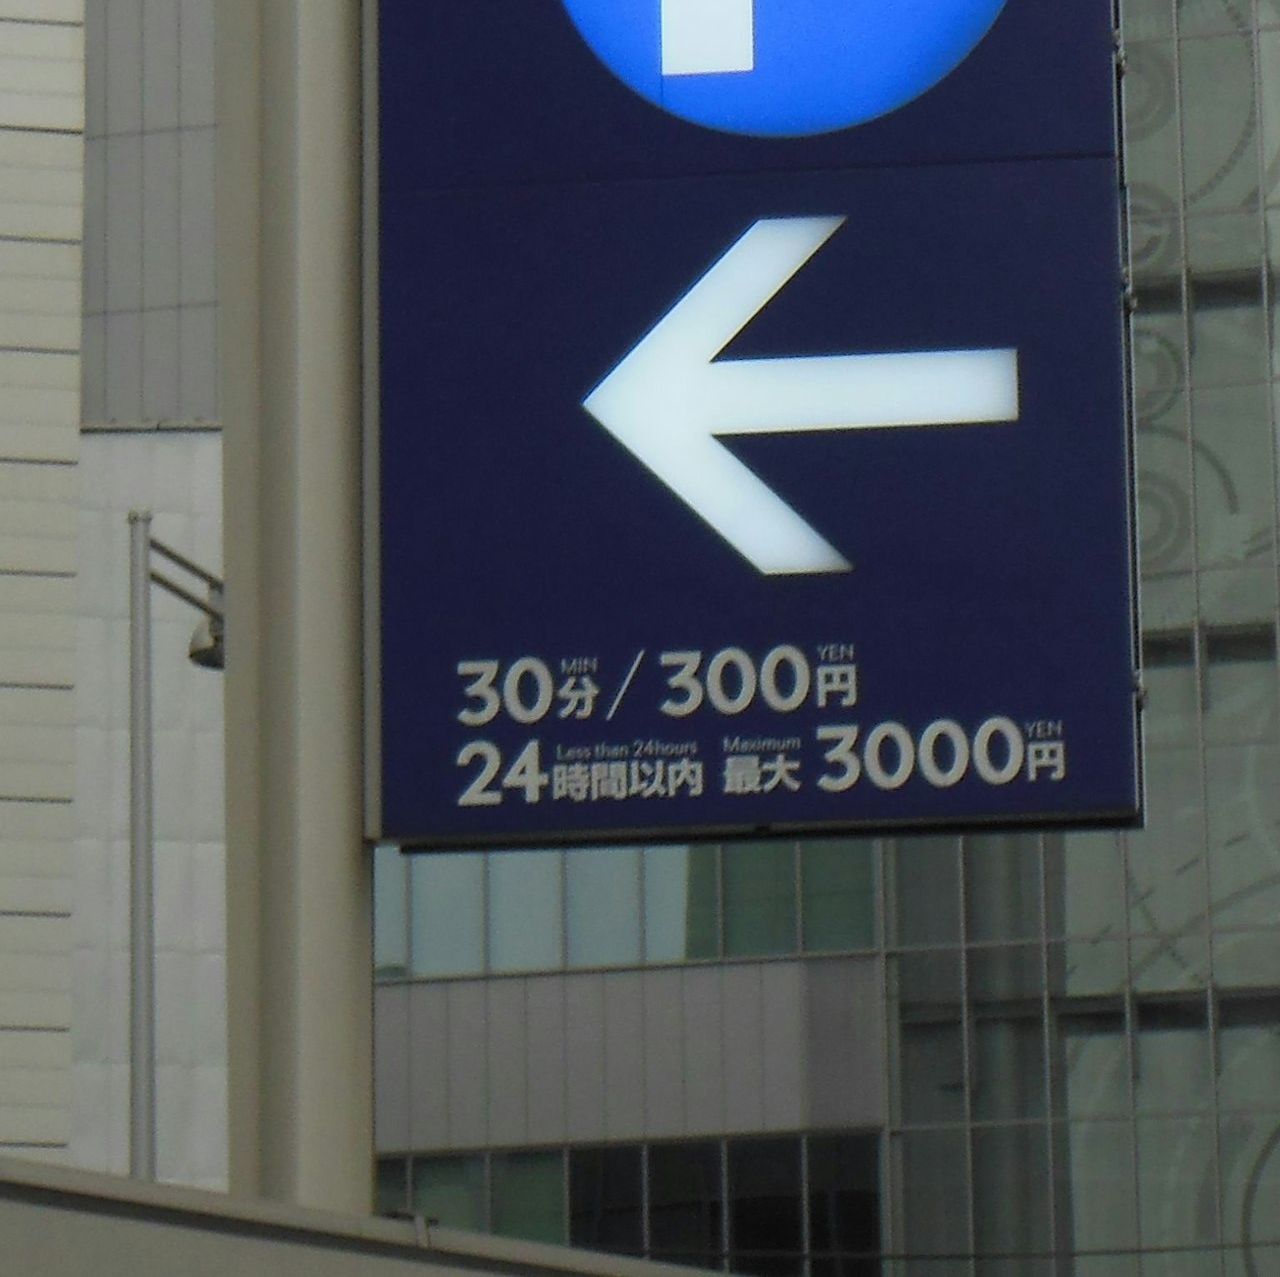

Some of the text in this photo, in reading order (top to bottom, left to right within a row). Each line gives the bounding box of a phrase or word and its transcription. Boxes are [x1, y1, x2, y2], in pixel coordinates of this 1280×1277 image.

[817, 643, 856, 662] YEN
[1026, 721, 1063, 738] YEN
[723, 736, 802, 754] Maximum
